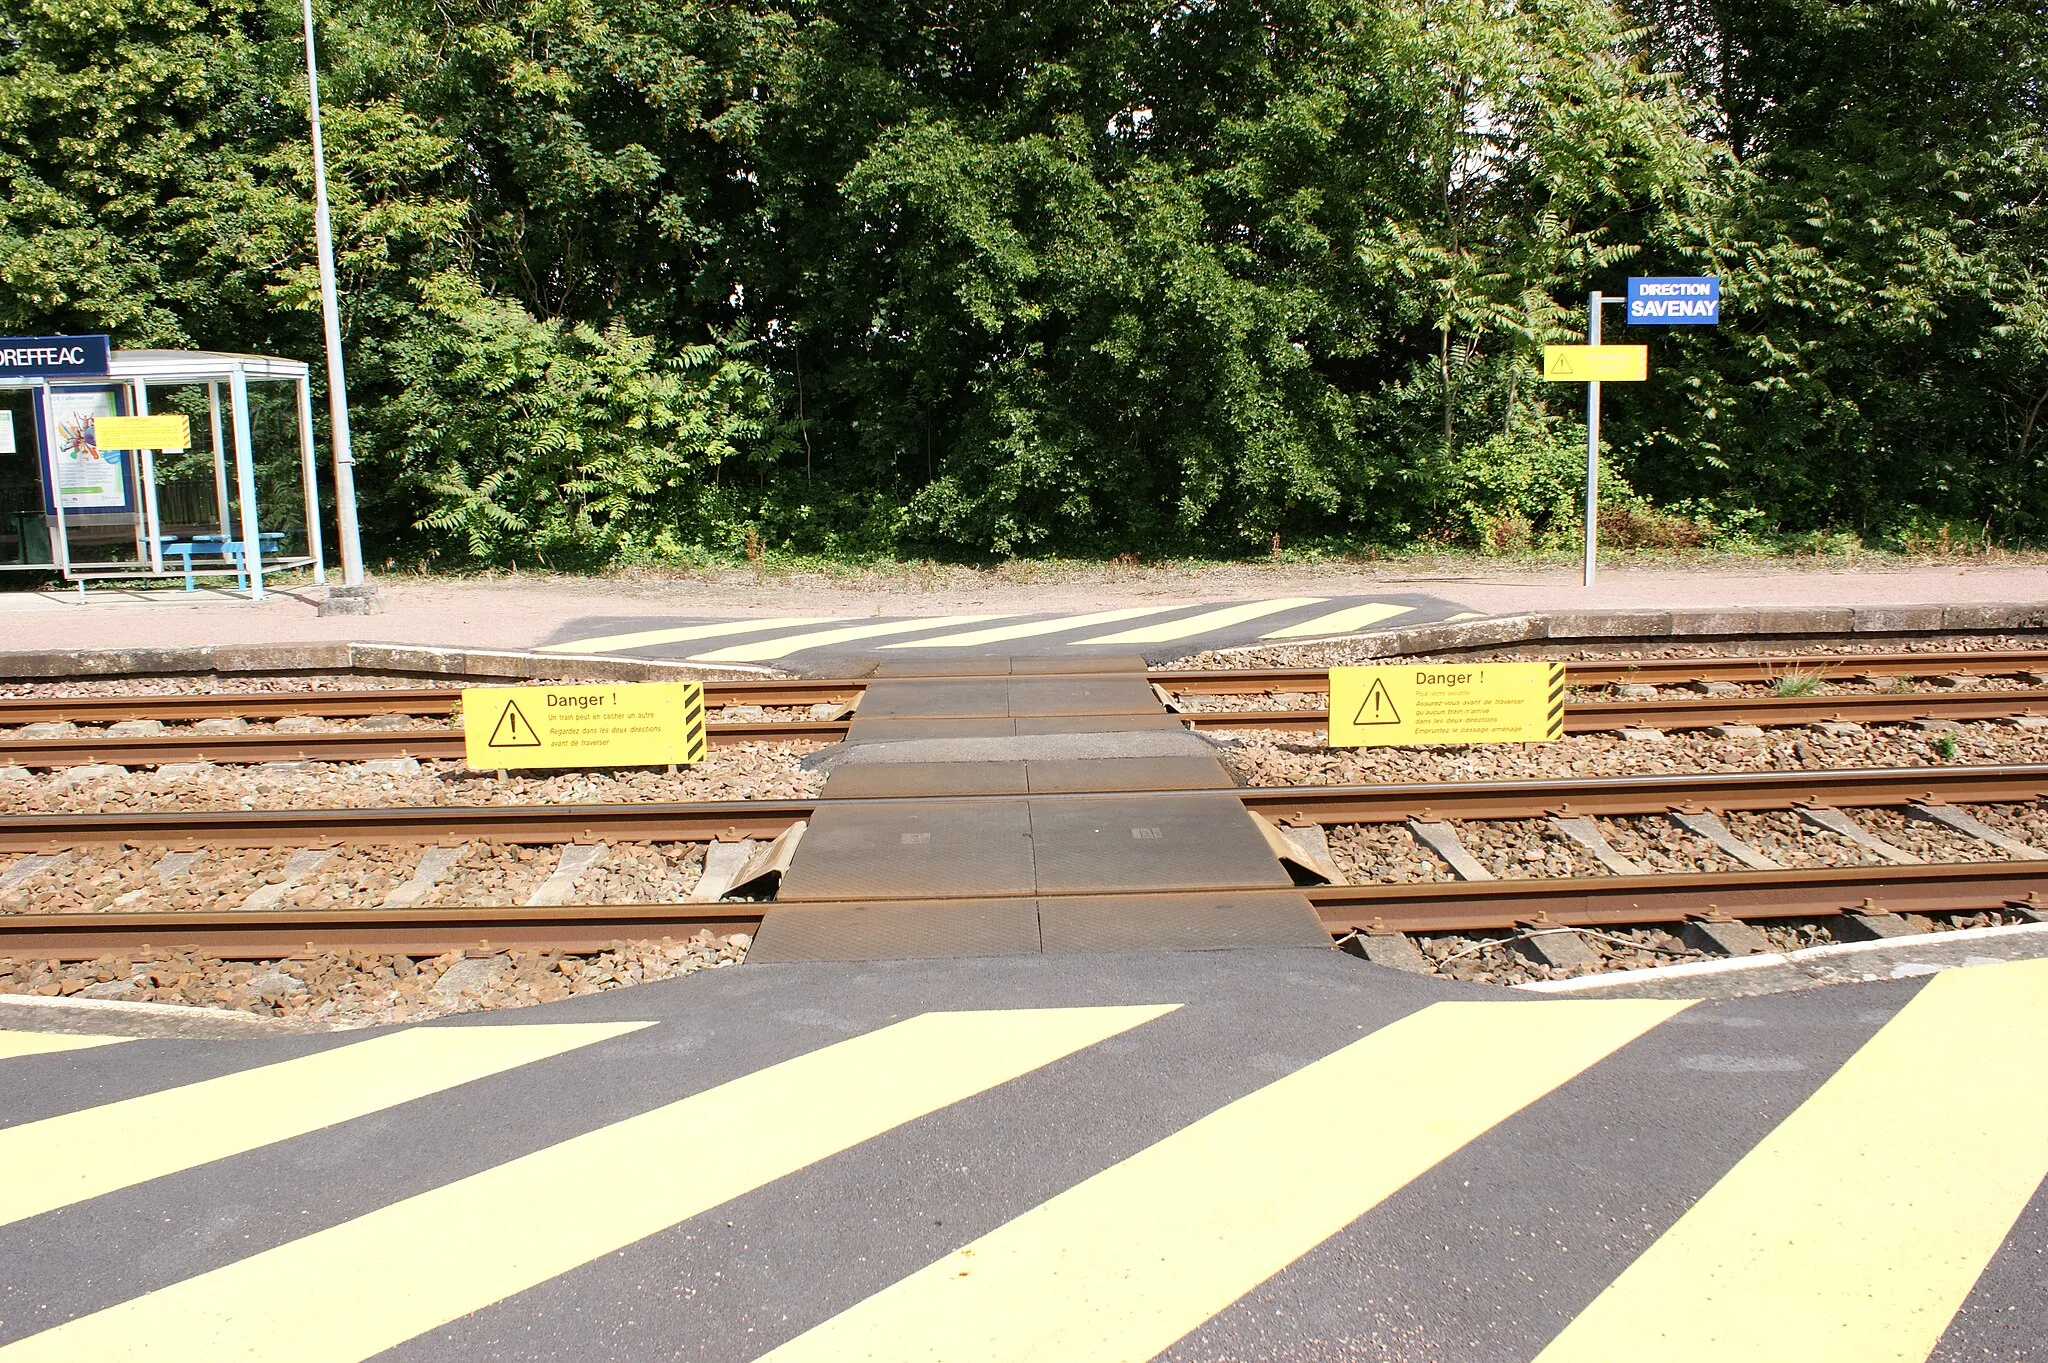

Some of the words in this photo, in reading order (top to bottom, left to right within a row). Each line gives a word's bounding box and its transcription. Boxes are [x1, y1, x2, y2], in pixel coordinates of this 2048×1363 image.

[1640, 284, 1711, 296] DIRECTION
[1631, 300, 1718, 317] SAVENAY
[1416, 672, 1472, 687] Danger
[1480, 671, 1484, 683] !
[547, 694, 604, 709] Danger
[613, 693, 616, 705] !
[550, 727, 580, 737] Regardez
